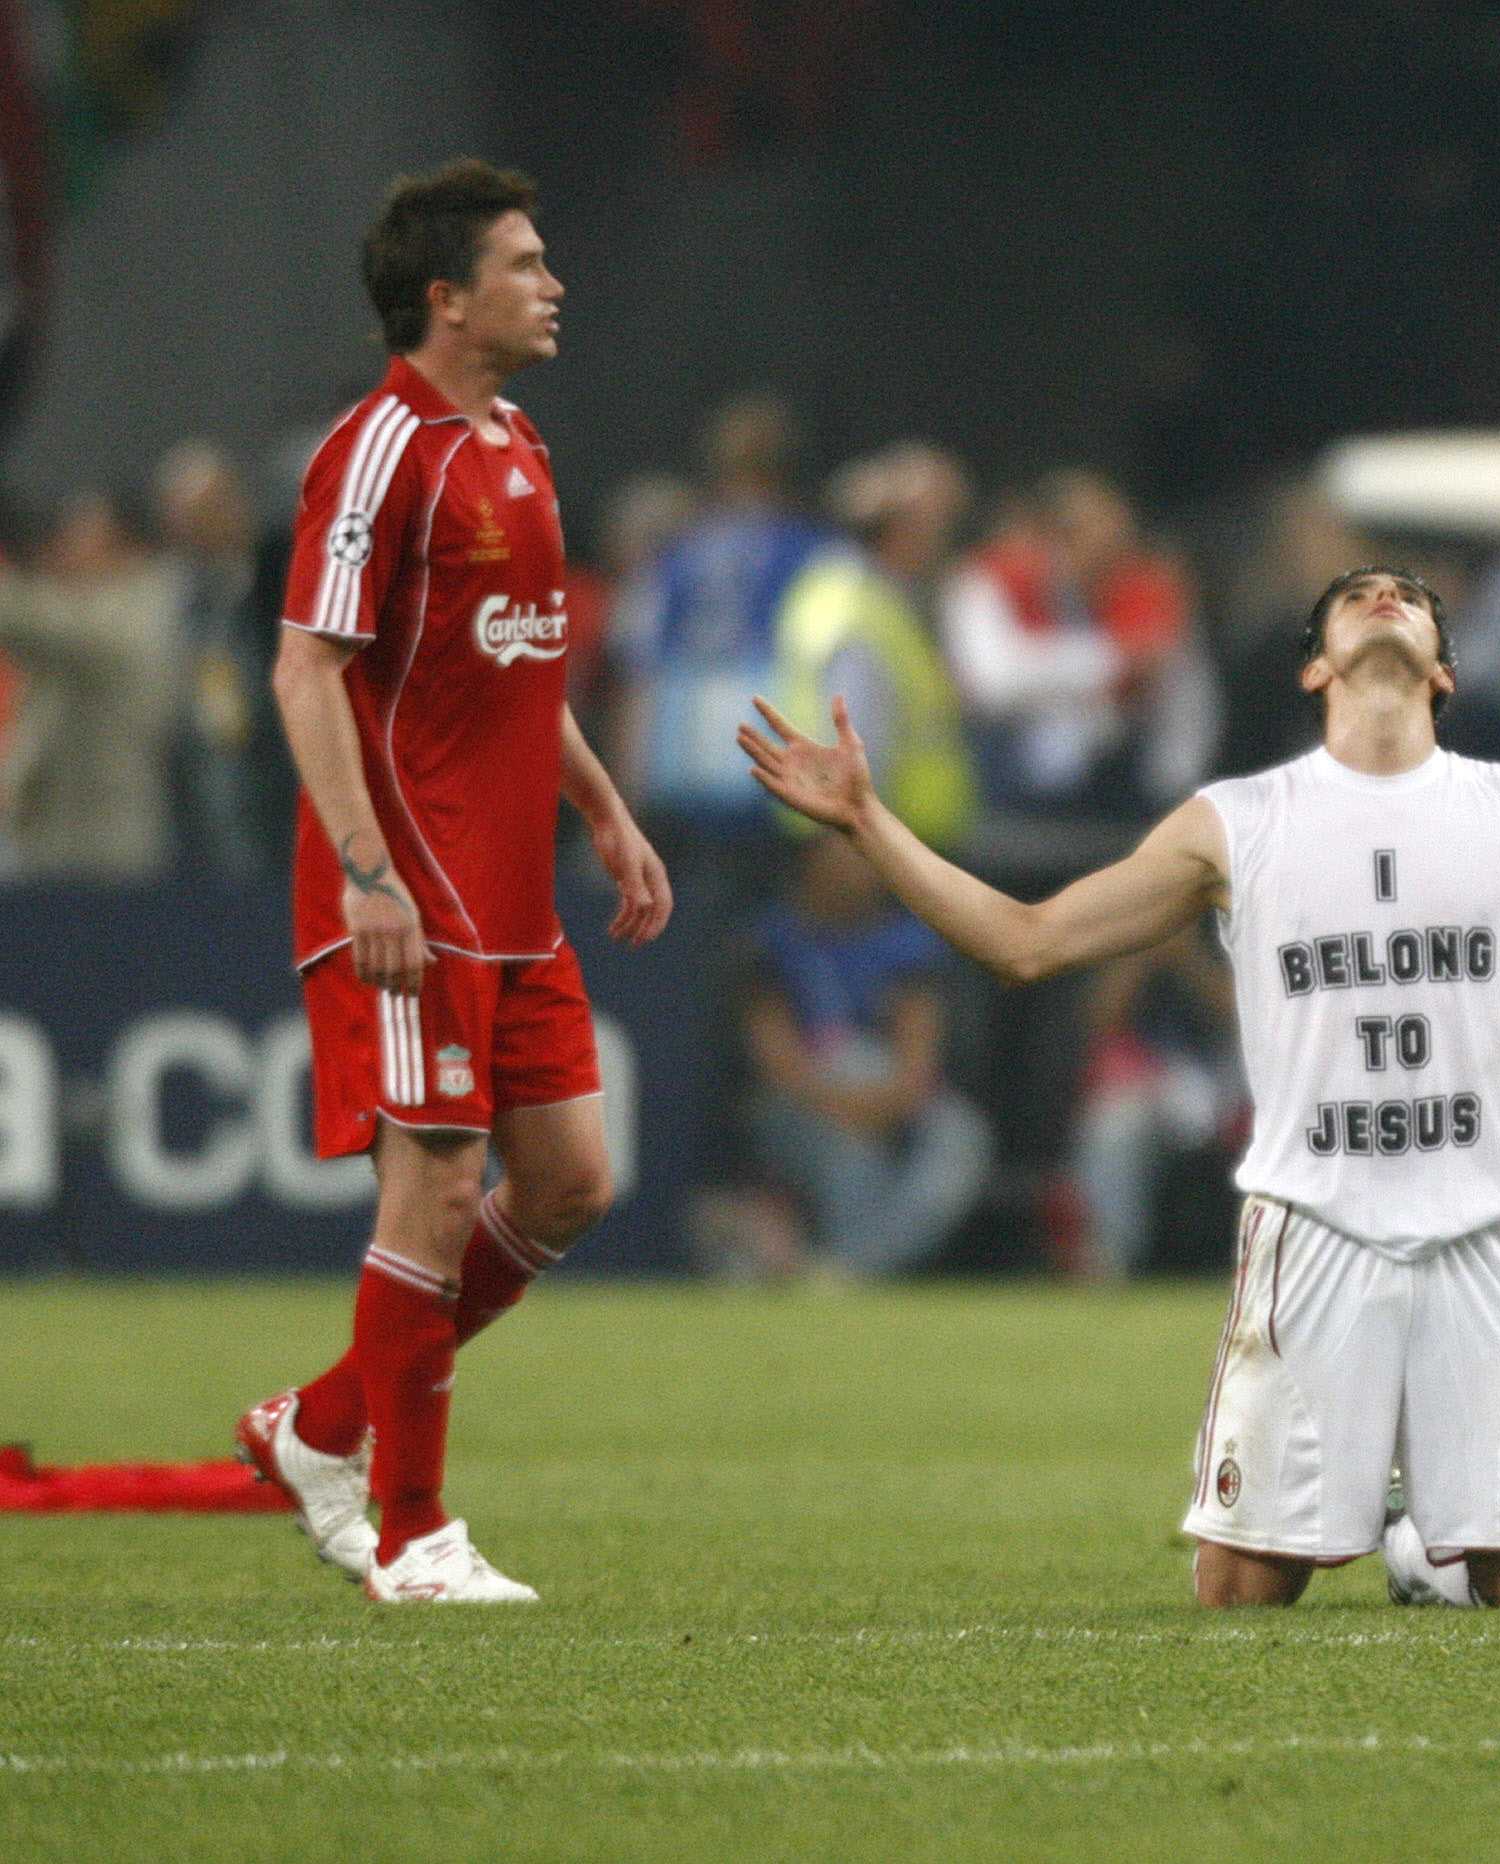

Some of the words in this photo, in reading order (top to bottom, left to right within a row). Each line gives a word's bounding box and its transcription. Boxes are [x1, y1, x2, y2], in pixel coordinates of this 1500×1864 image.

[1374, 848, 1397, 901] I
[1277, 926, 1496, 999] BELONG
[1356, 1013, 1431, 1071] TO
[1306, 1092, 1481, 1157] JESUS
